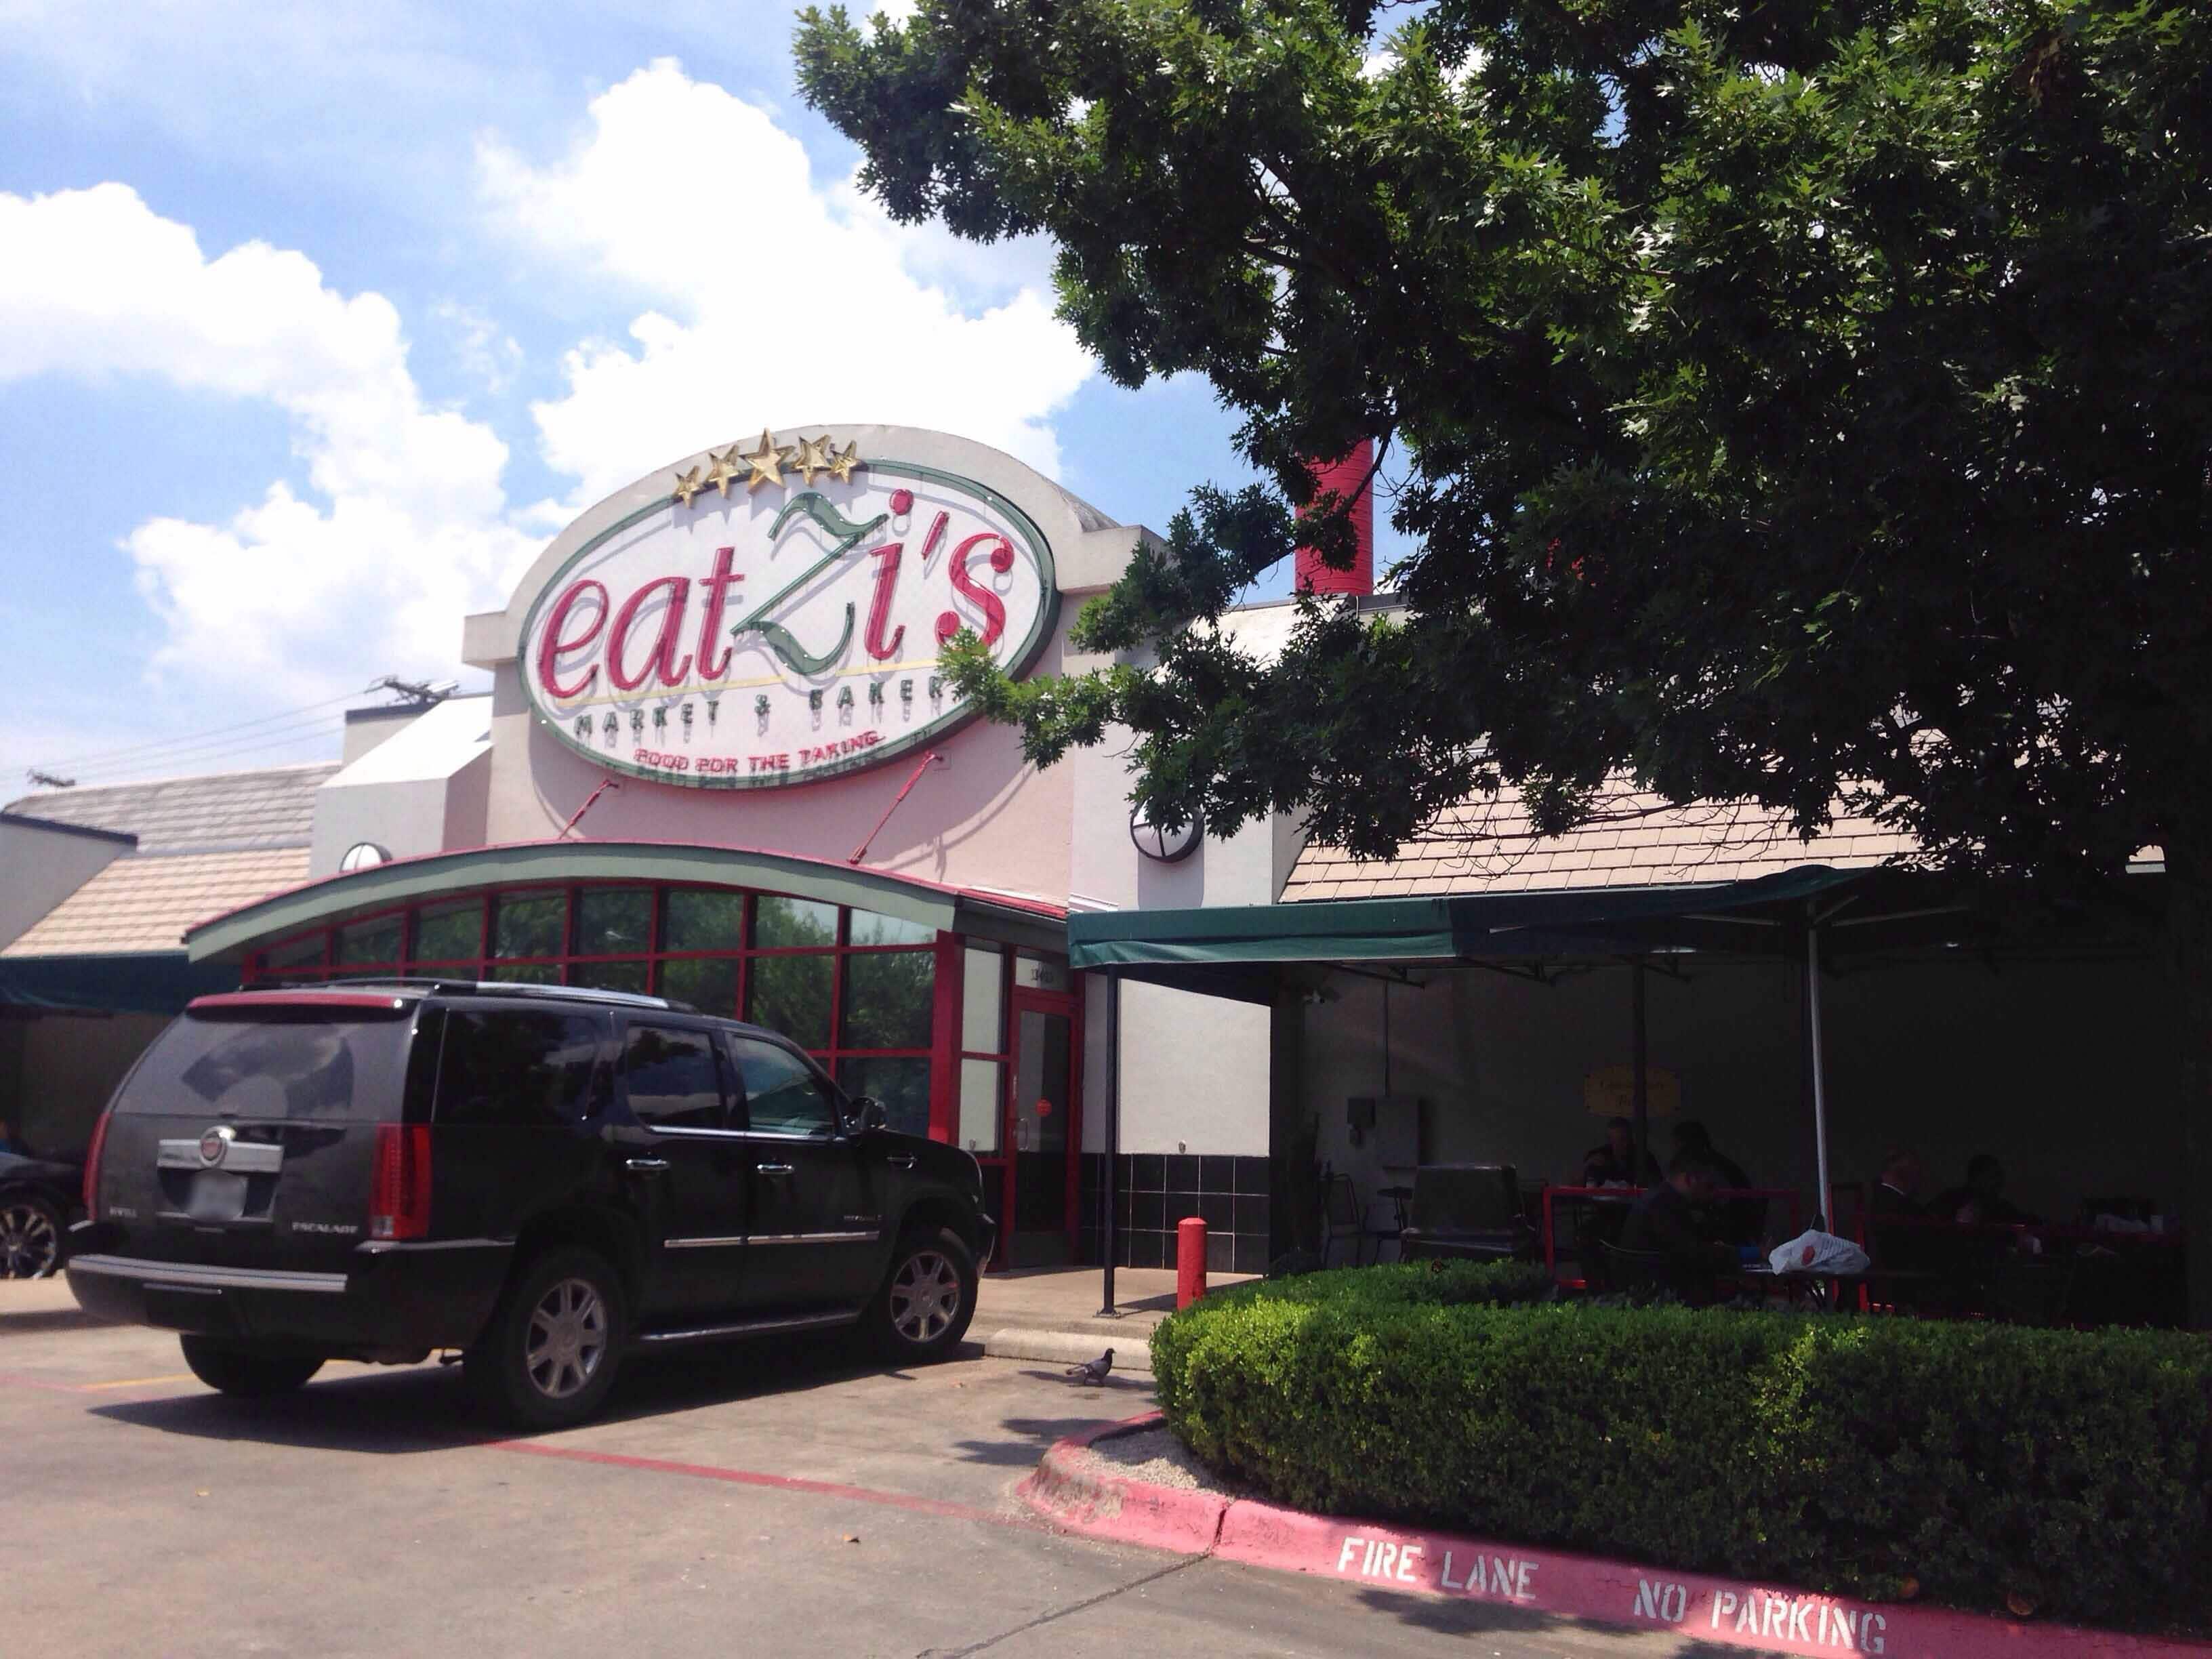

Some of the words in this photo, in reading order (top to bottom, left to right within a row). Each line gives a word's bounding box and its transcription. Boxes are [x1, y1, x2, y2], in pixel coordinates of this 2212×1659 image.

[574, 700, 719, 735] MARKET
[754, 694, 771, 715] &
[809, 676, 944, 710] BAKER
[634, 748, 689, 771] FOOD
[695, 758, 737, 773] FOR
[748, 754, 790, 771] THE
[798, 730, 885, 766] TAKING
[1337, 1536, 1424, 1584] FIRE
[1441, 1551, 1540, 1601] LANE
[1634, 1579, 1687, 1624] NO
[1711, 1589, 1887, 1655] PARKING
